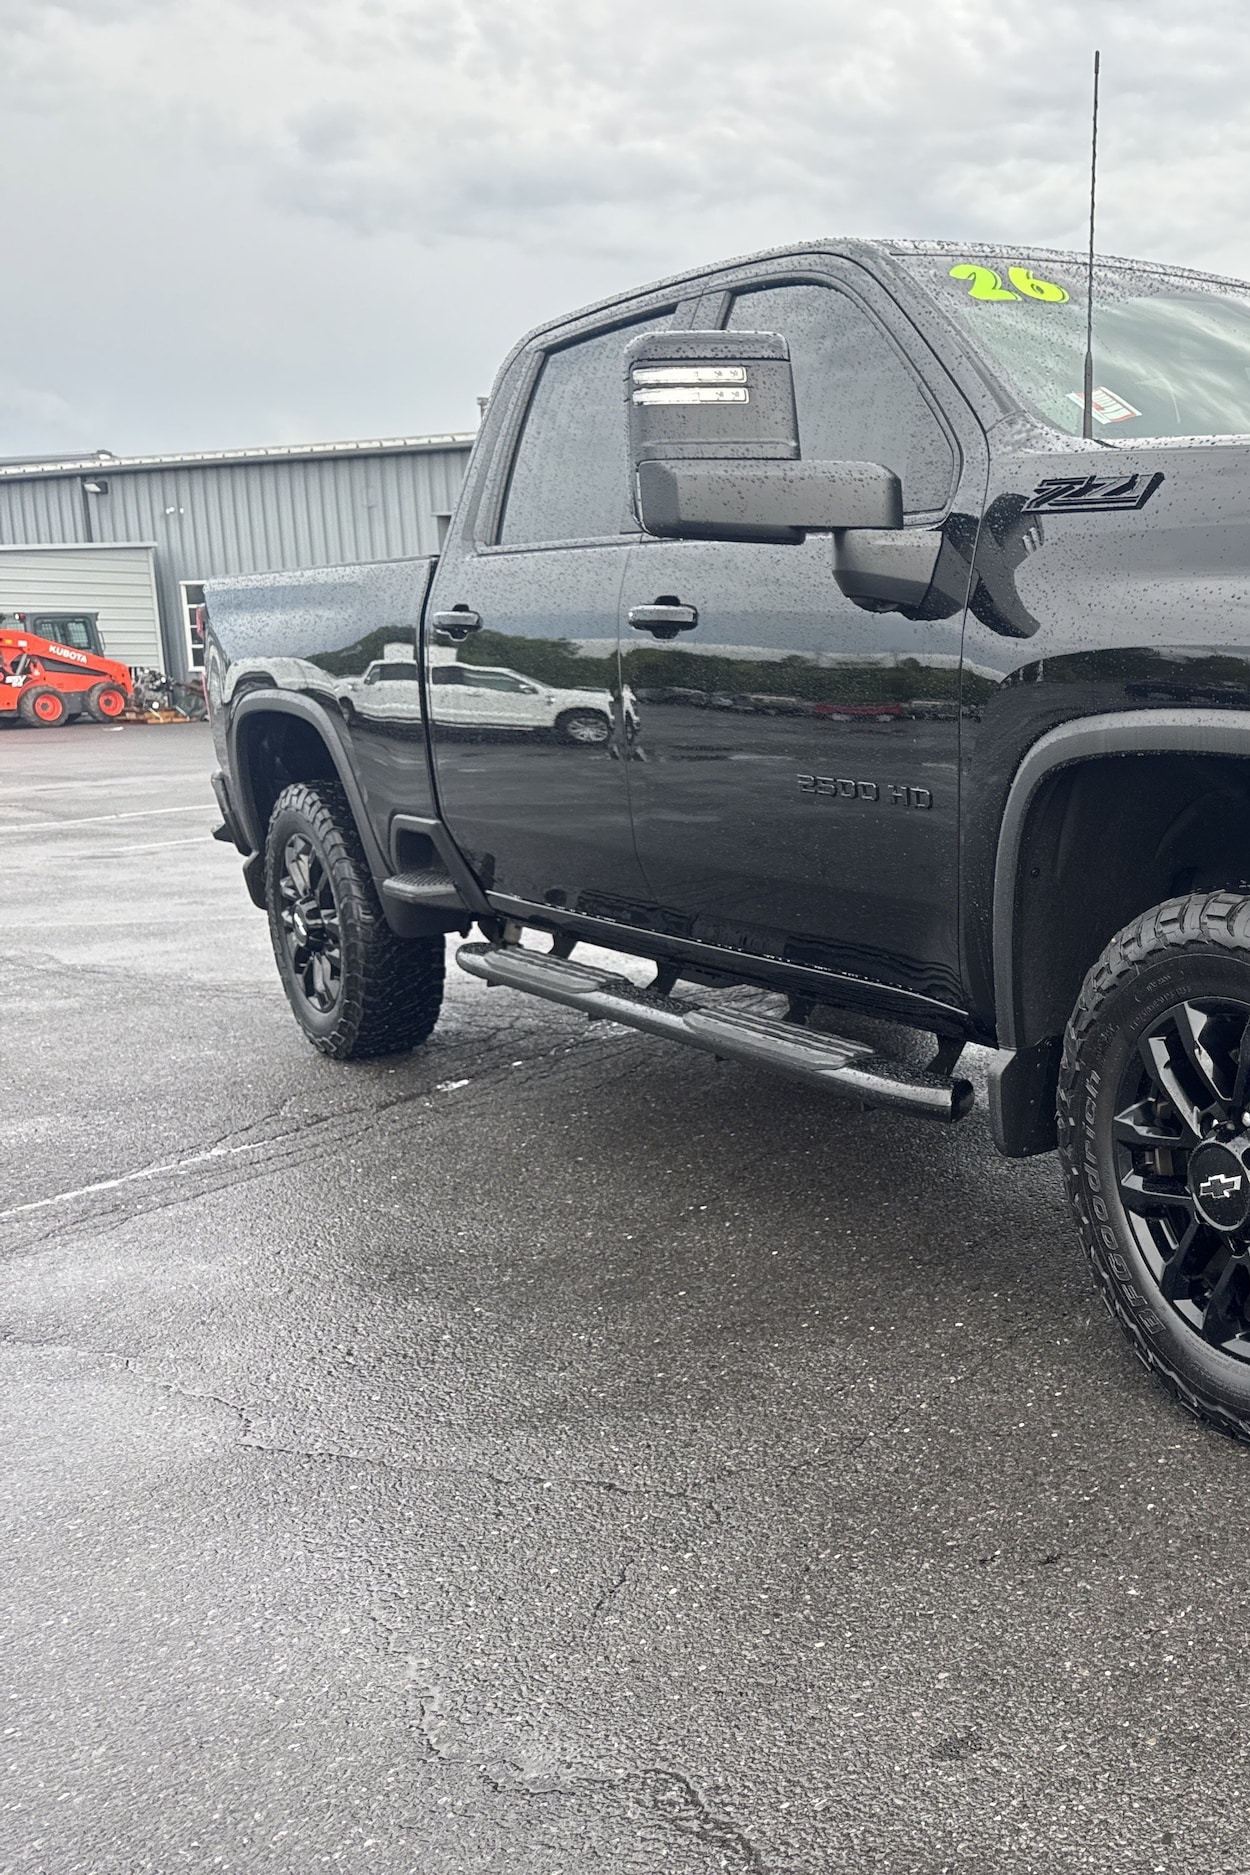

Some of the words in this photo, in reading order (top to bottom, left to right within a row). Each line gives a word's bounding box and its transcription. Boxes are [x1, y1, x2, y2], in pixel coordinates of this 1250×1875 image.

[949, 263, 1070, 304] 26
[1021, 472, 1165, 515] Z71
[48, 644, 88, 664] KUBOTA
[797, 773, 880, 802] 2500
[887, 783, 934, 810] HD
